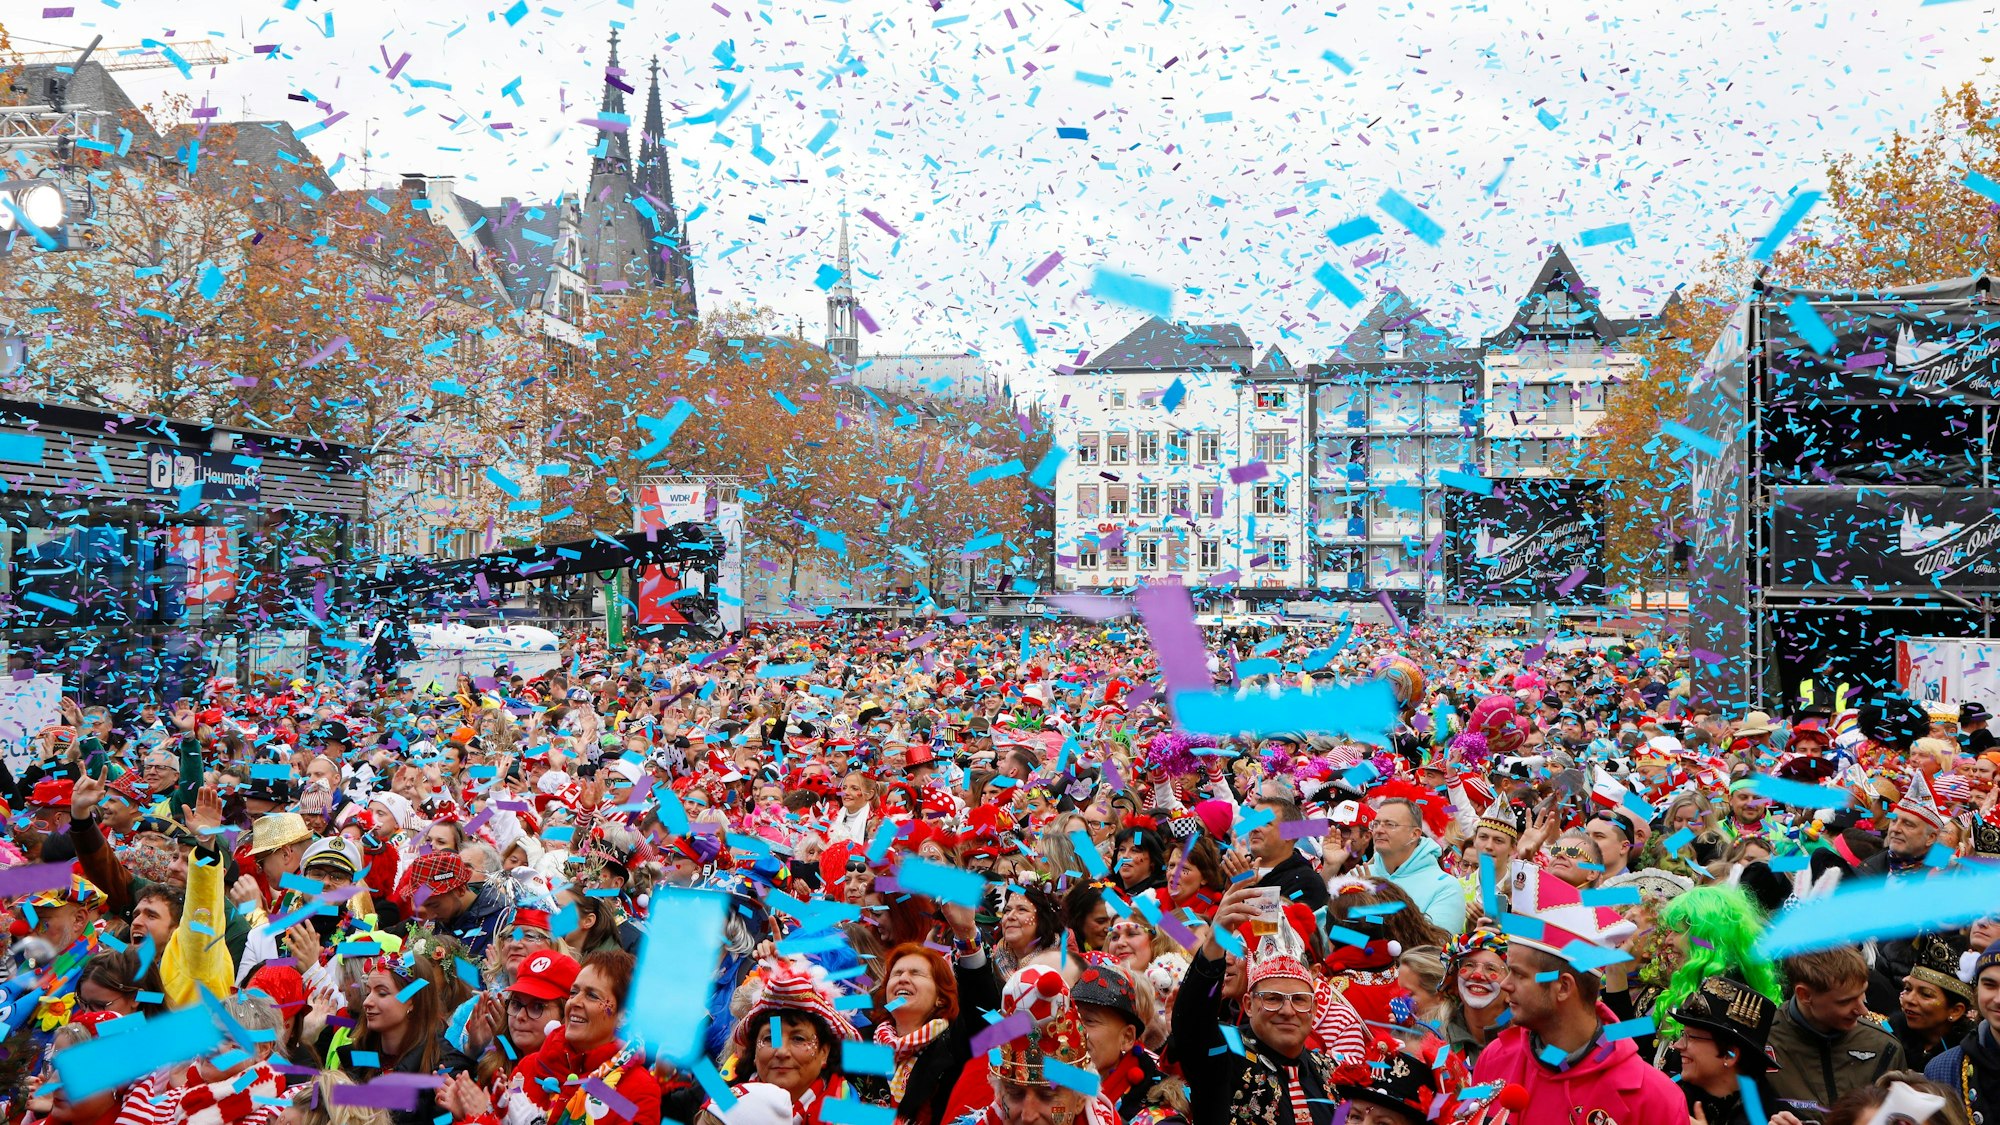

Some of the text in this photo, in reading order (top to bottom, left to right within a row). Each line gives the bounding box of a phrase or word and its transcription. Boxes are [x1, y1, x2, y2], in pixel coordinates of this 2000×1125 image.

[203, 467, 256, 487] Heumarkt
[1254, 580, 1285, 588] HOTEL
[533, 960, 548, 970] M
